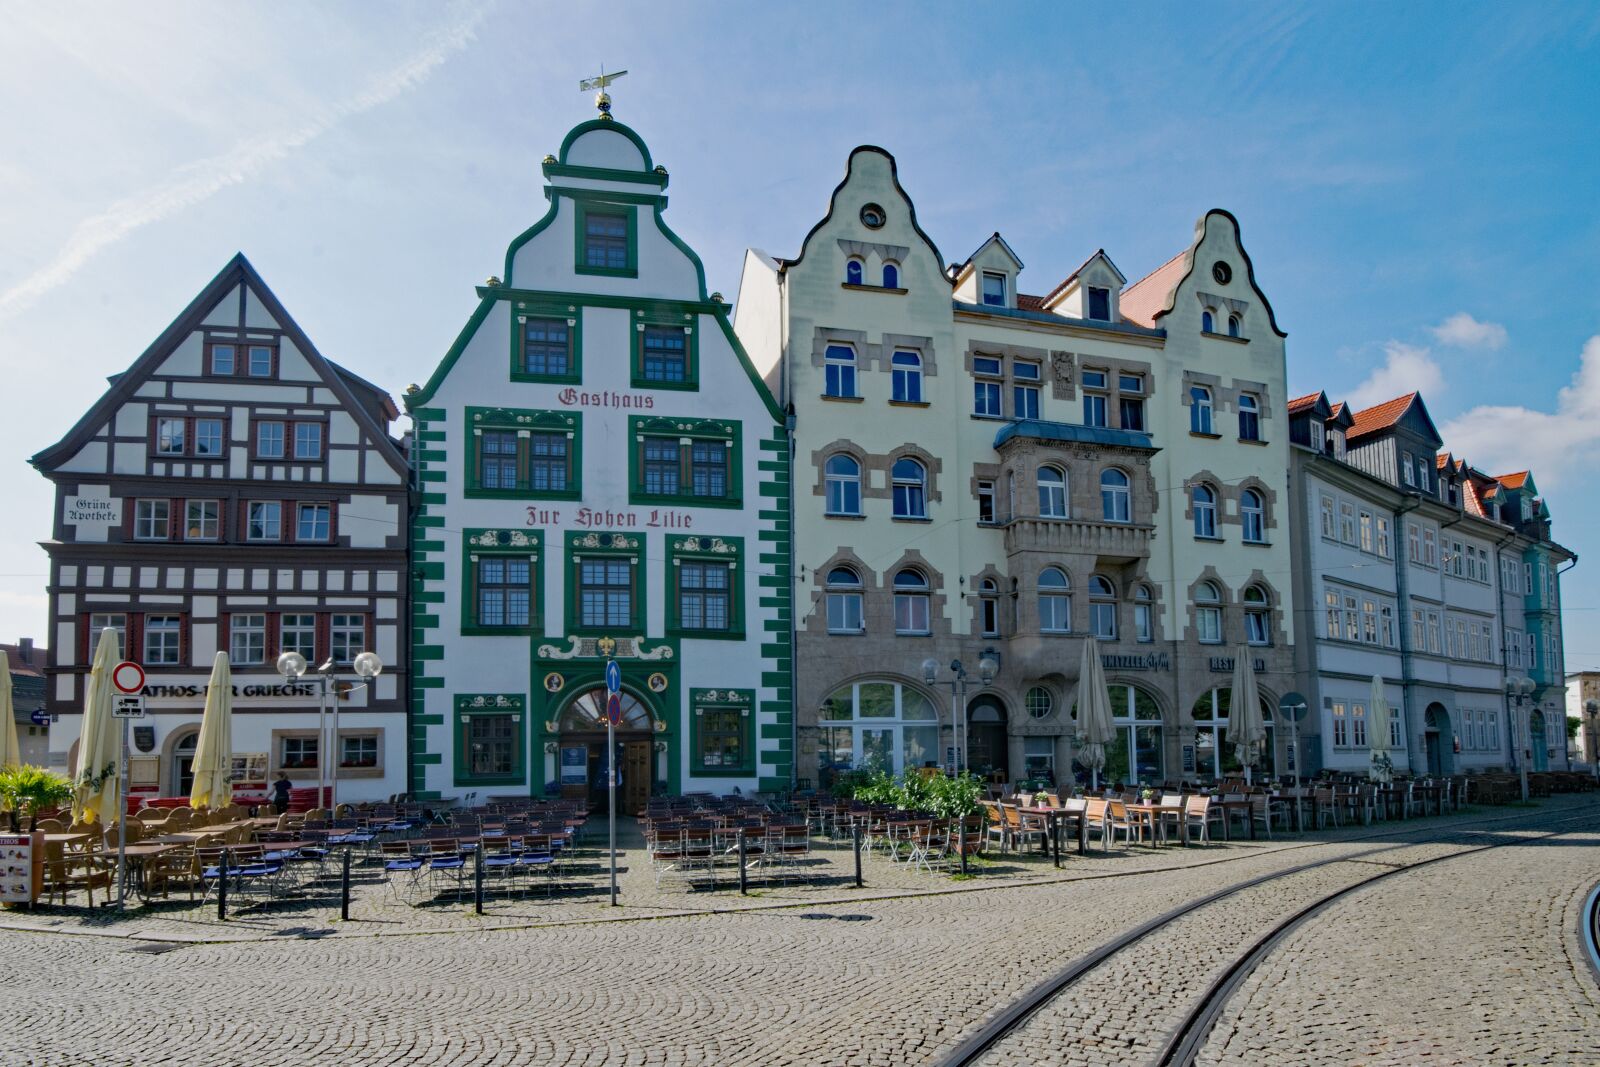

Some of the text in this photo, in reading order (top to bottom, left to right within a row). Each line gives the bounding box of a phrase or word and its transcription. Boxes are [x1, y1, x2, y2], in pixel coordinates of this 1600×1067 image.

[558, 388, 654, 409] Gasthaus
[76, 499, 111, 510] Grüne
[69, 510, 117, 522] Apotheke
[526, 506, 693, 528] Zur Hohen Lilie
[243, 684, 315, 697] GRIECHE
